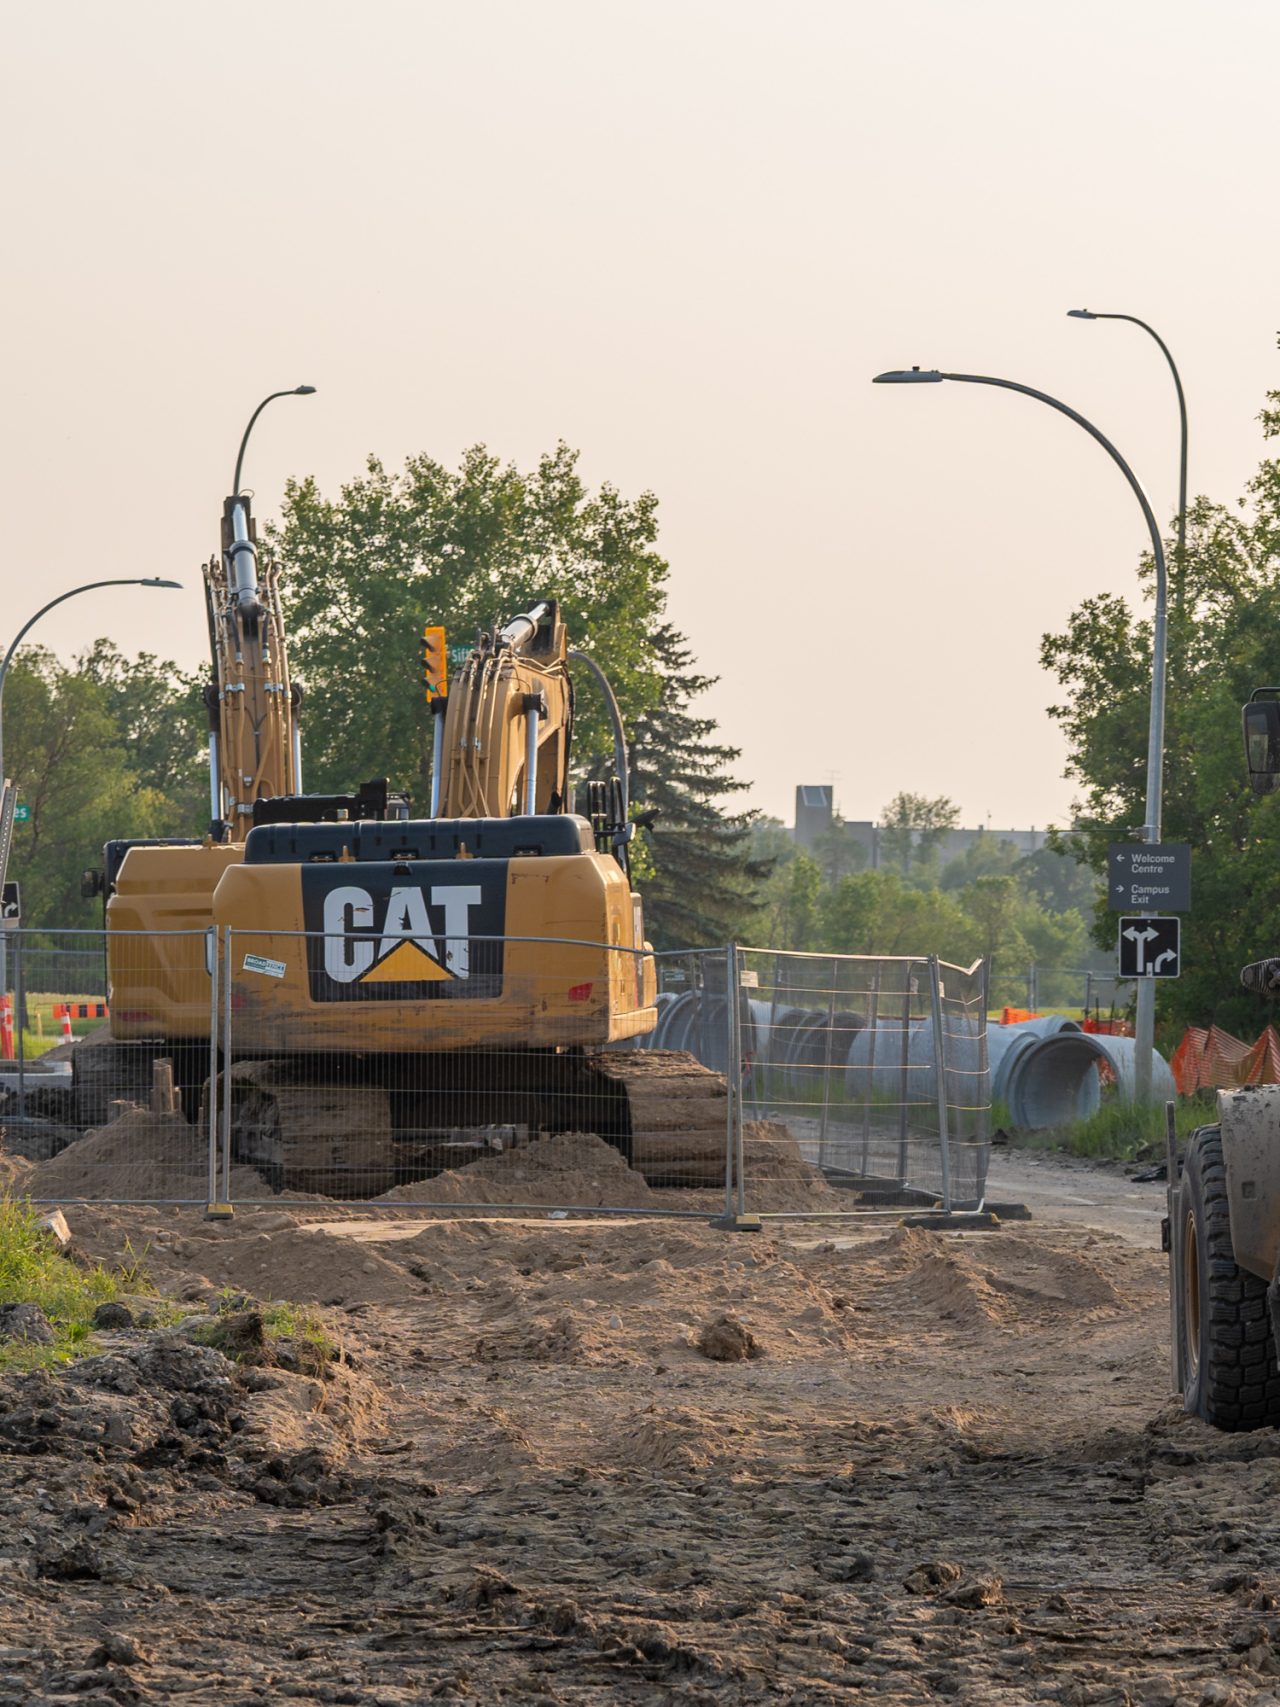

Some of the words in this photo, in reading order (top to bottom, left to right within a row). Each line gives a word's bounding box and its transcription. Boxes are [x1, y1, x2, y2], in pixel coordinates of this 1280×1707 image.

[14, 807, 27, 818] es
[1131, 853, 1175, 863] Welcome
[1131, 864, 1163, 873] Centre
[1131, 884, 1170, 895] Campus
[1131, 895, 1149, 904] Exit
[323, 885, 482, 983] CAT
